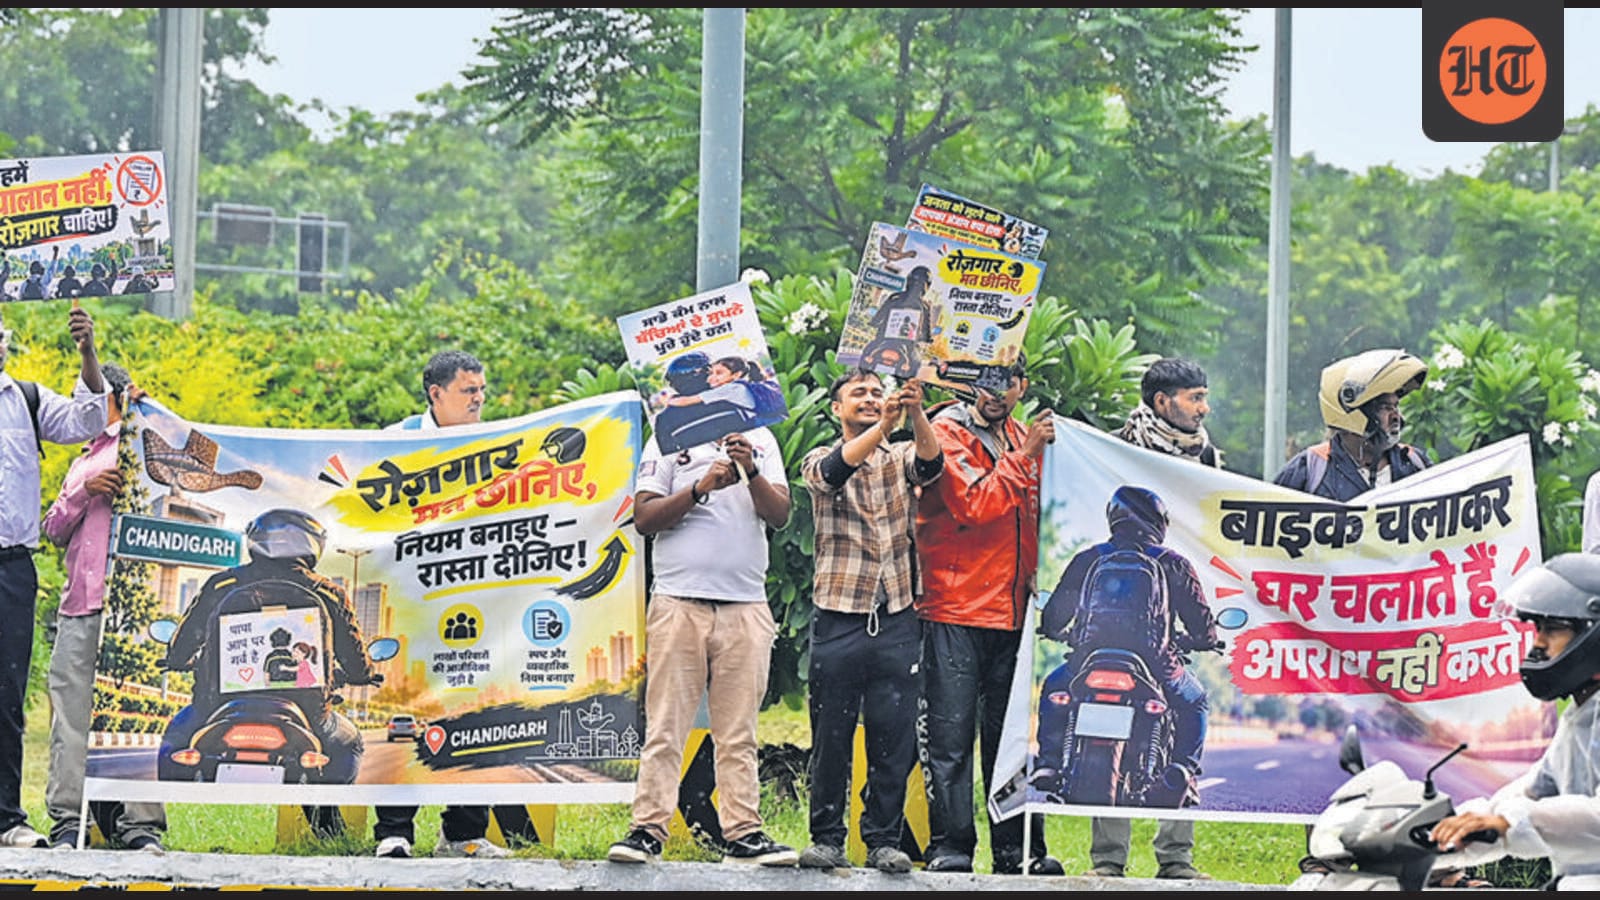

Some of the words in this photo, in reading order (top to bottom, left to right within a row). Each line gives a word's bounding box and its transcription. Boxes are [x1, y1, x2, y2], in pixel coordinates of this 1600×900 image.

[0, 160, 28, 187] हमें
[63, 208, 113, 234] चाहिए!
[946, 250, 1005, 274] रोज़गार
[960, 274, 979, 286] मत
[697, 294, 726, 311] ਨਾਲ
[690, 314, 703, 327] ਦੇ
[357, 438, 524, 512] रोज़गार
[474, 459, 597, 508] छीनिए,
[1220, 499, 1368, 559] बाइक
[1376, 475, 1512, 545] चलाकर
[126, 527, 236, 557] CHANDIGARH
[394, 526, 464, 561] नियम
[470, 514, 550, 544] बनाइए
[417, 554, 485, 588] रास्ता
[493, 540, 587, 579] दीजिए!
[1252, 569, 1325, 622] घर
[1331, 549, 1456, 624] चलाते
[229, 622, 252, 635] पापा
[227, 638, 248, 651] आप
[251, 635, 265, 648] पर
[550, 647, 567, 659] और
[432, 662, 445, 673] की
[1243, 638, 1373, 680] अपराध
[1375, 631, 1445, 695] नहीं
[468, 673, 475, 685] है
[520, 670, 544, 683] नियम
[451, 720, 548, 747] CHANDIGARH
[916, 697, 935, 801] SWIGGY
